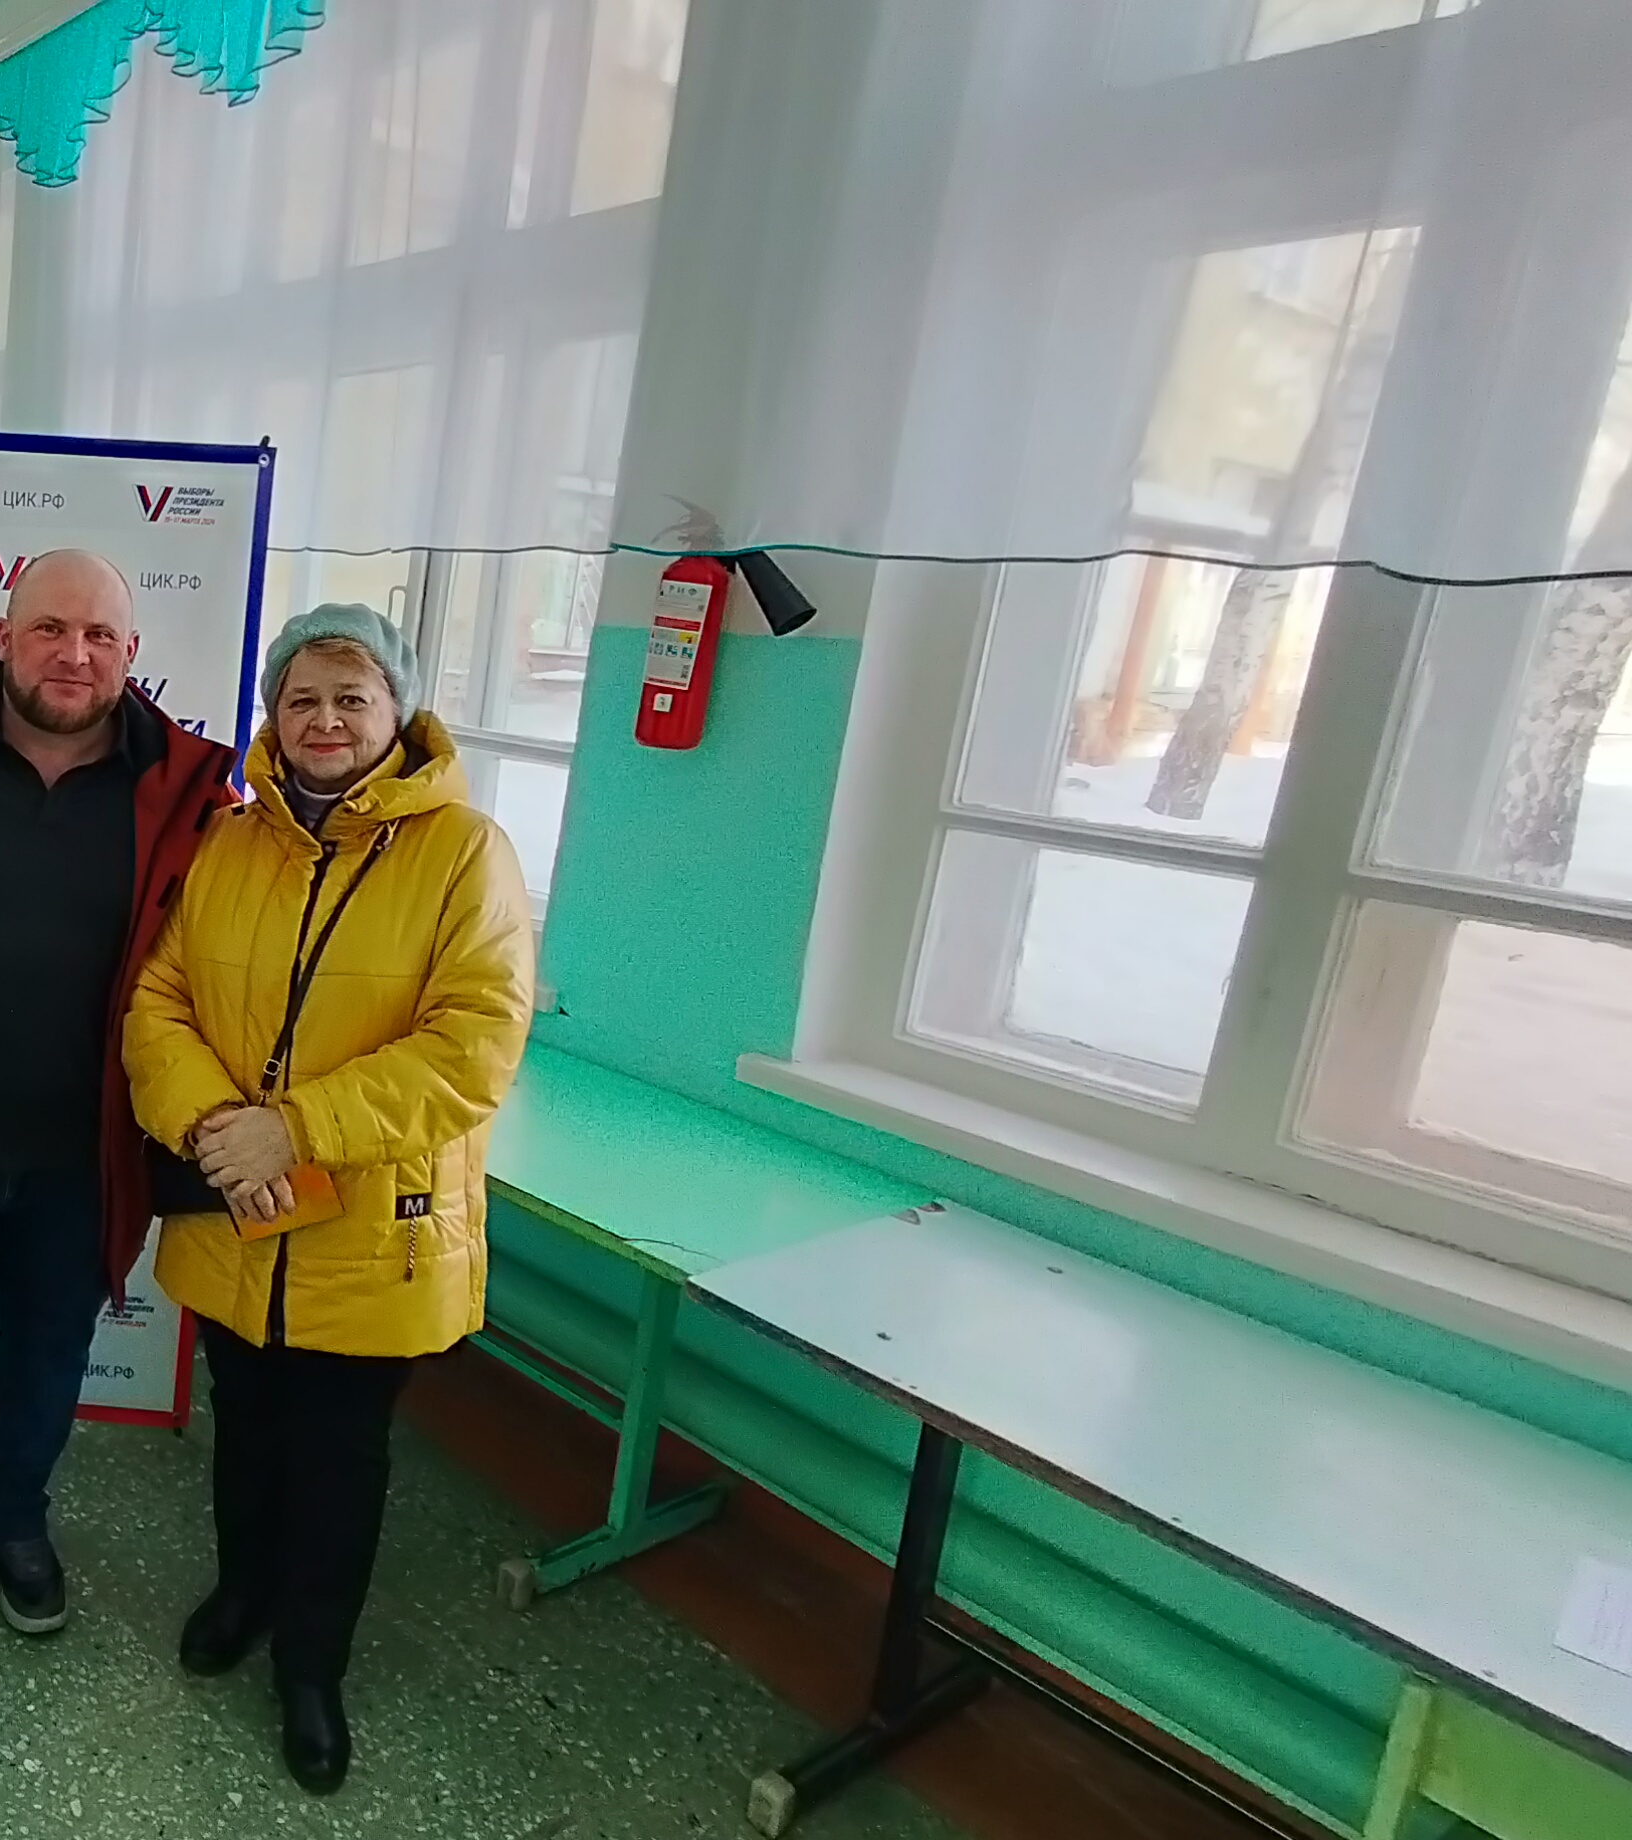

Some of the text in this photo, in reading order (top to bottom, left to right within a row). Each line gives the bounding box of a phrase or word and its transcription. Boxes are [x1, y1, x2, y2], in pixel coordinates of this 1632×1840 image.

[177, 487, 215, 496] ВЫБОРЫ
[3, 490, 65, 509] ЦИК.РФ
[172, 497, 225, 507] ПРЕЗИДЕНТА
[167, 507, 201, 516] РОССИИ
[140, 572, 202, 591] ЦИК.РФ
[405, 1197, 425, 1215] M
